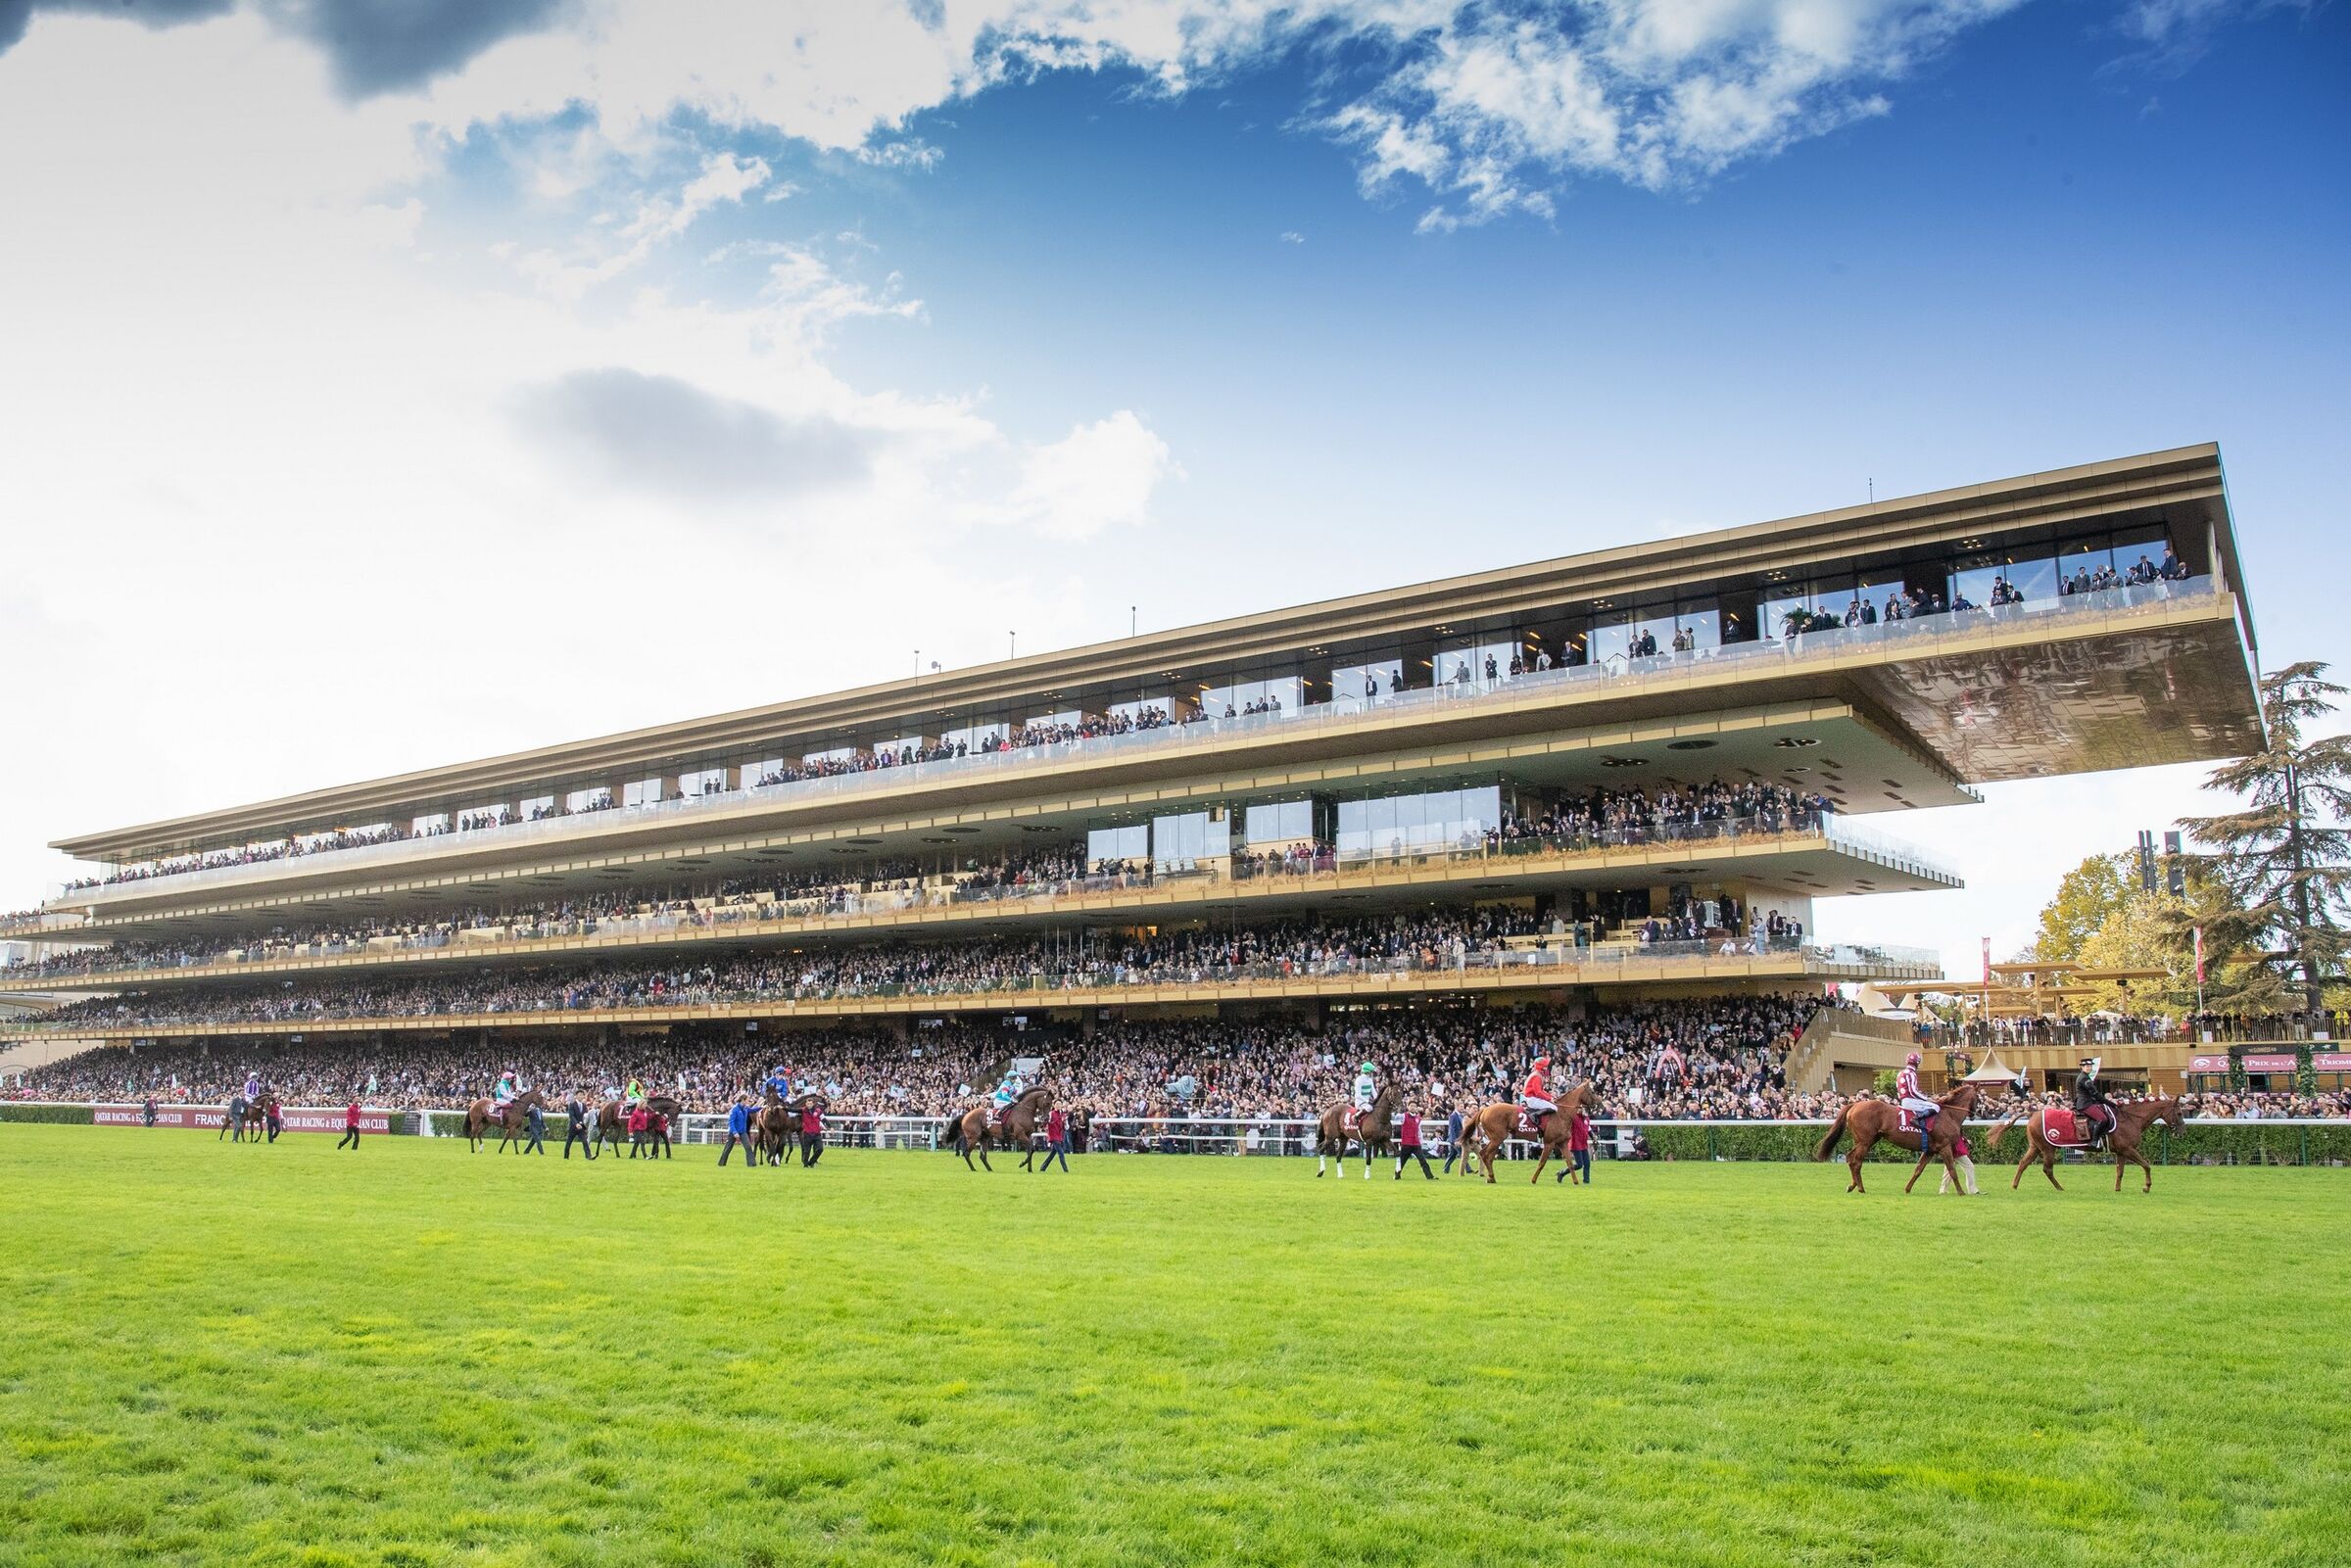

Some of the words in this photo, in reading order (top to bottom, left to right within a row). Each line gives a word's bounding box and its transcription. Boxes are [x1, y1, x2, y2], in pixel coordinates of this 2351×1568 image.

[195, 1114, 226, 1125] FRANC
[302, 1117, 325, 1128] RACING
[371, 1118, 389, 1129] CLUB
[1518, 1113, 1528, 1127] 2
[1898, 1110, 1906, 1126] 1
